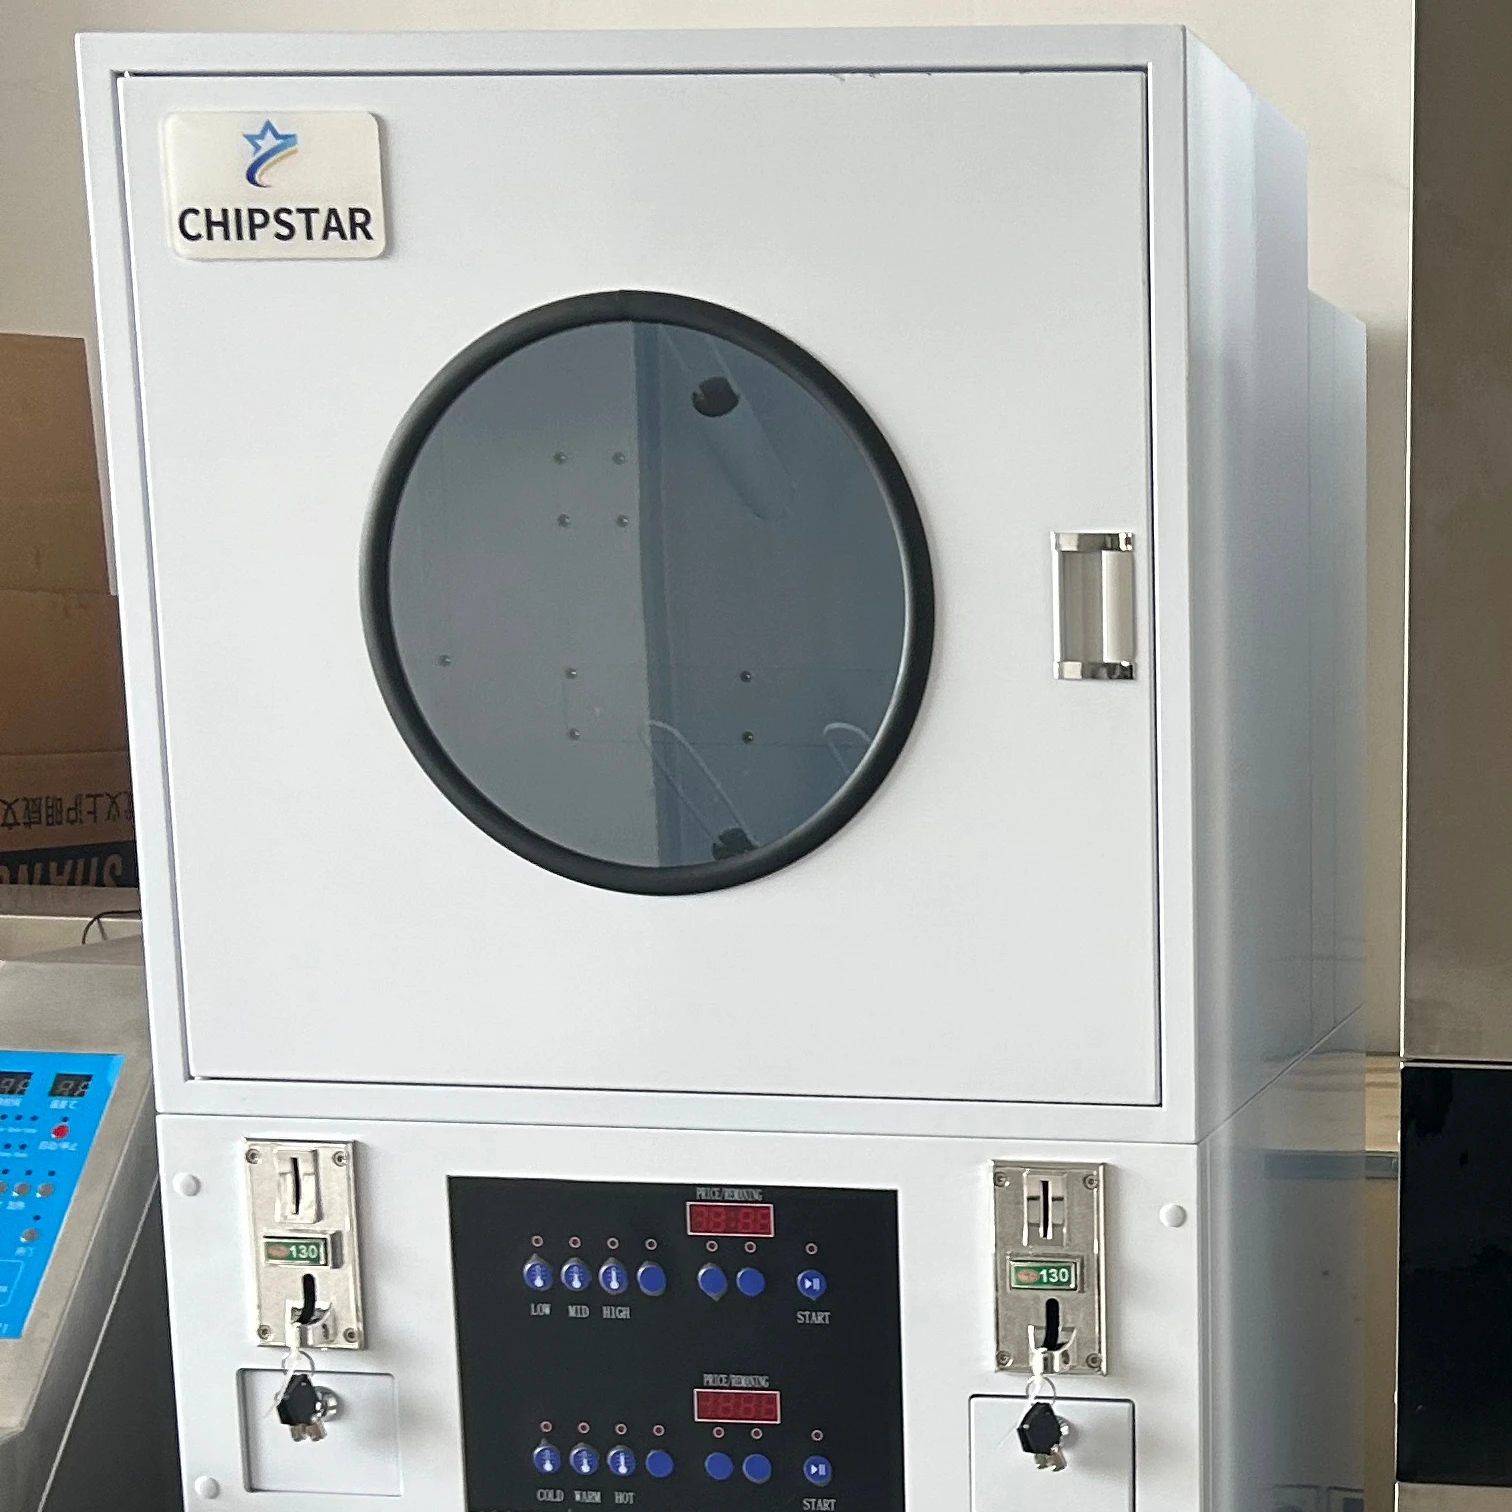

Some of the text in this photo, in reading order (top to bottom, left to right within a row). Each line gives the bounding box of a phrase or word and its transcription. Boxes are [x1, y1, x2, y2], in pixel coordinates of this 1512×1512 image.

[178, 207, 375, 242] CHIPSTAR
[290, 1244, 319, 1259] 130
[1040, 1268, 1070, 1283] 130
[531, 1303, 631, 1320] LOW MID HIGH
[797, 1310, 831, 1326] START
[537, 1489, 635, 1505] COLD WARM HOT
[803, 1498, 836, 1512] START
